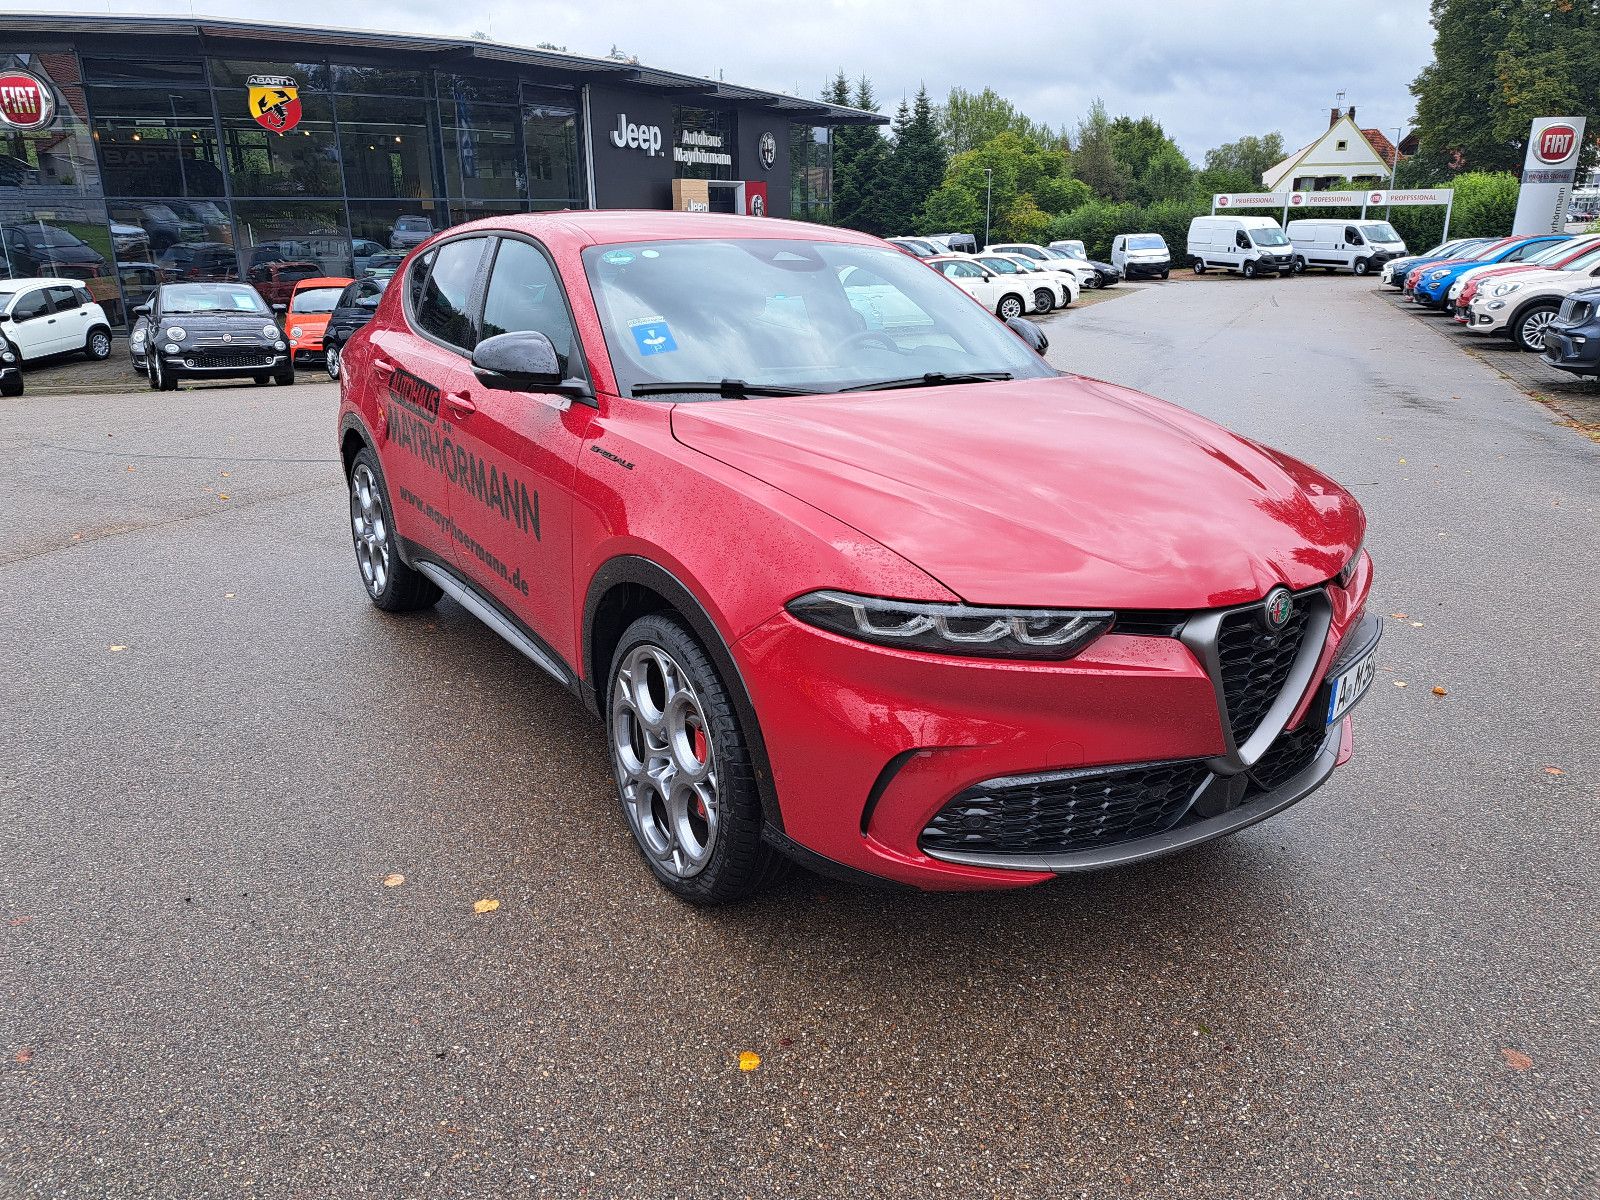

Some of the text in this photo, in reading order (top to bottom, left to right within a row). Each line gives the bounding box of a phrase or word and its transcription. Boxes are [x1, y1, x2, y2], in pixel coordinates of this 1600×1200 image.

[248, 77, 295, 86] ABARTH
[0, 86, 37, 114] FIAT
[609, 113, 662, 157] Jeep
[681, 129, 723, 148] Autohaus
[1543, 134, 1572, 154] FIAT
[673, 147, 732, 166] Mayrhörmann
[1528, 172, 1571, 180] PROFESSIONAL
[390, 371, 440, 416] AUTOHAUS
[387, 403, 541, 542] MAYRHÖRMANN
[399, 485, 529, 597] www.mayrhoermann.de
